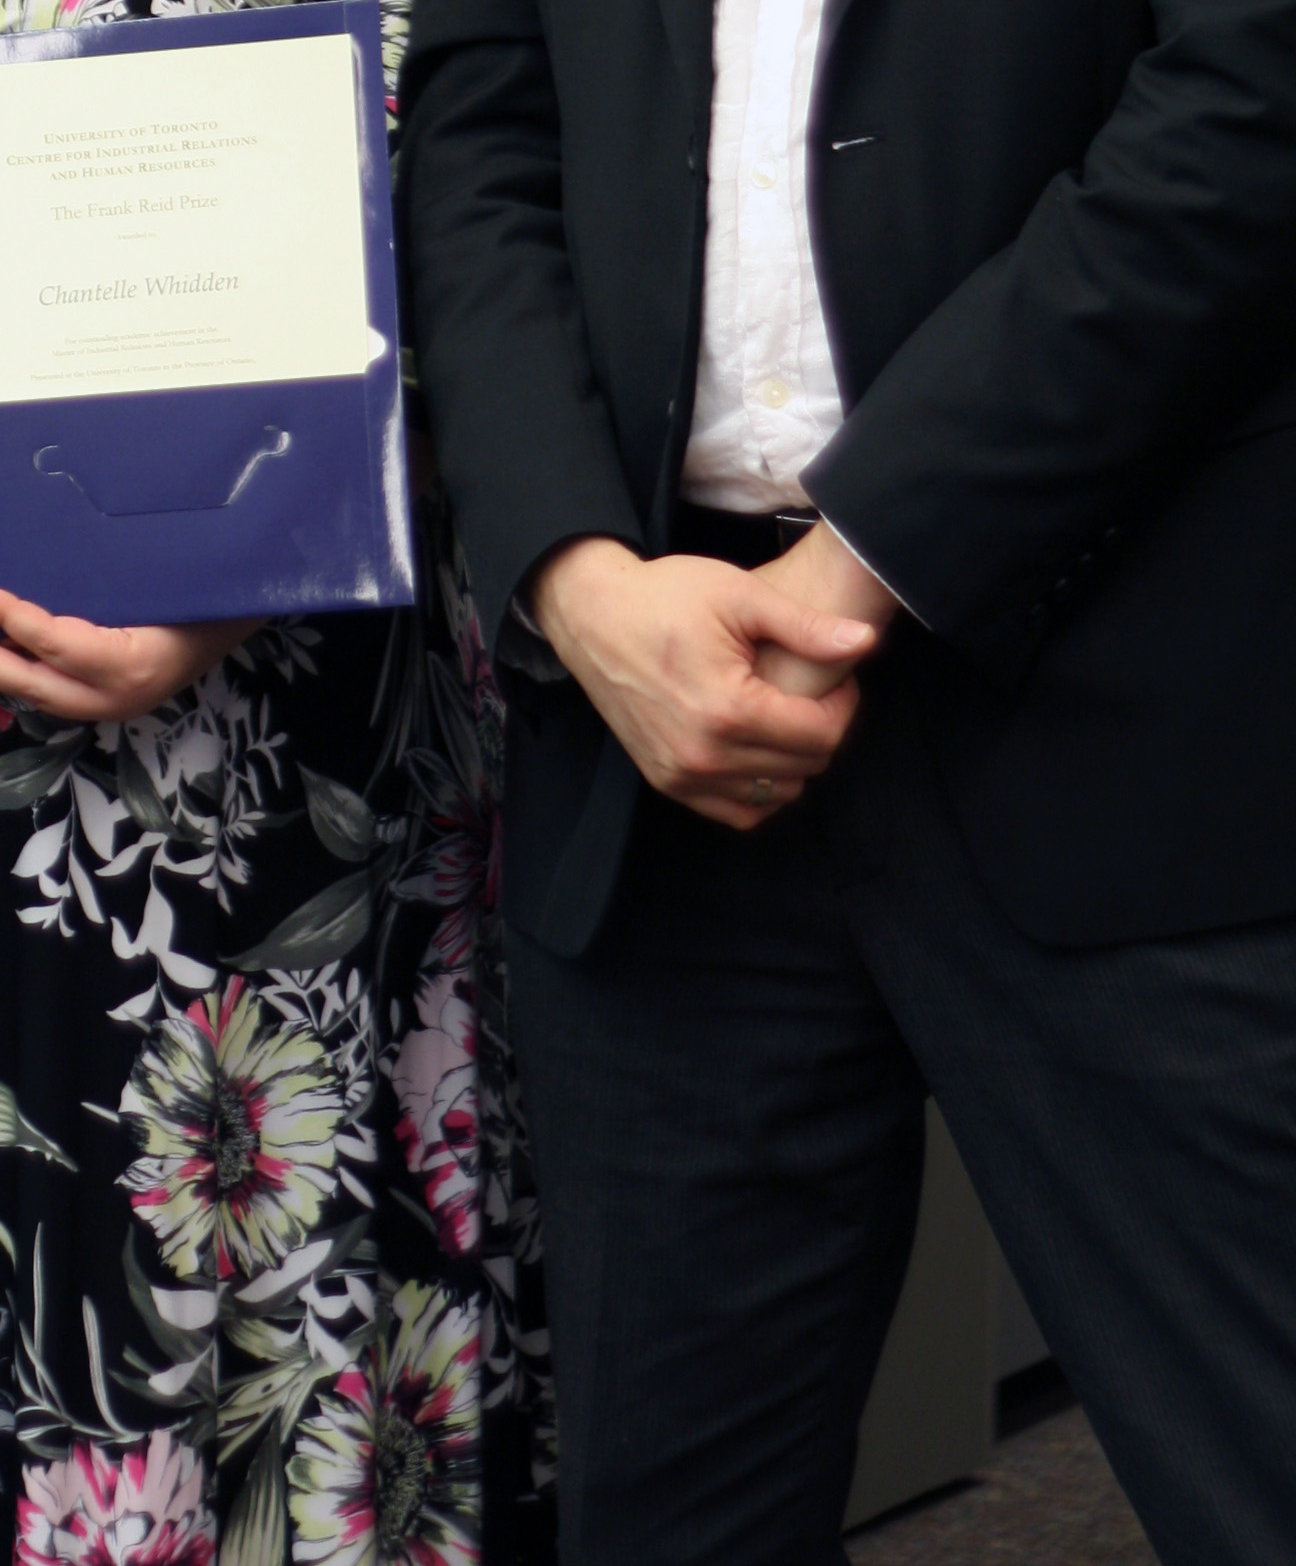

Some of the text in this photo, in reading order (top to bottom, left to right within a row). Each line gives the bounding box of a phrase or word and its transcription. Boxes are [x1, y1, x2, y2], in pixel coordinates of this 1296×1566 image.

[44, 121, 219, 145] UNIVERSITY OF TORONTO
[6, 135, 258, 166] CENTRE FOR INDUSTRIAL RELATIONS
[50, 157, 216, 181] AND HUMAN RESOURCES
[50, 192, 219, 221] The Frank Reid Prize
[38, 272, 239, 307] Chantelle Whidden
